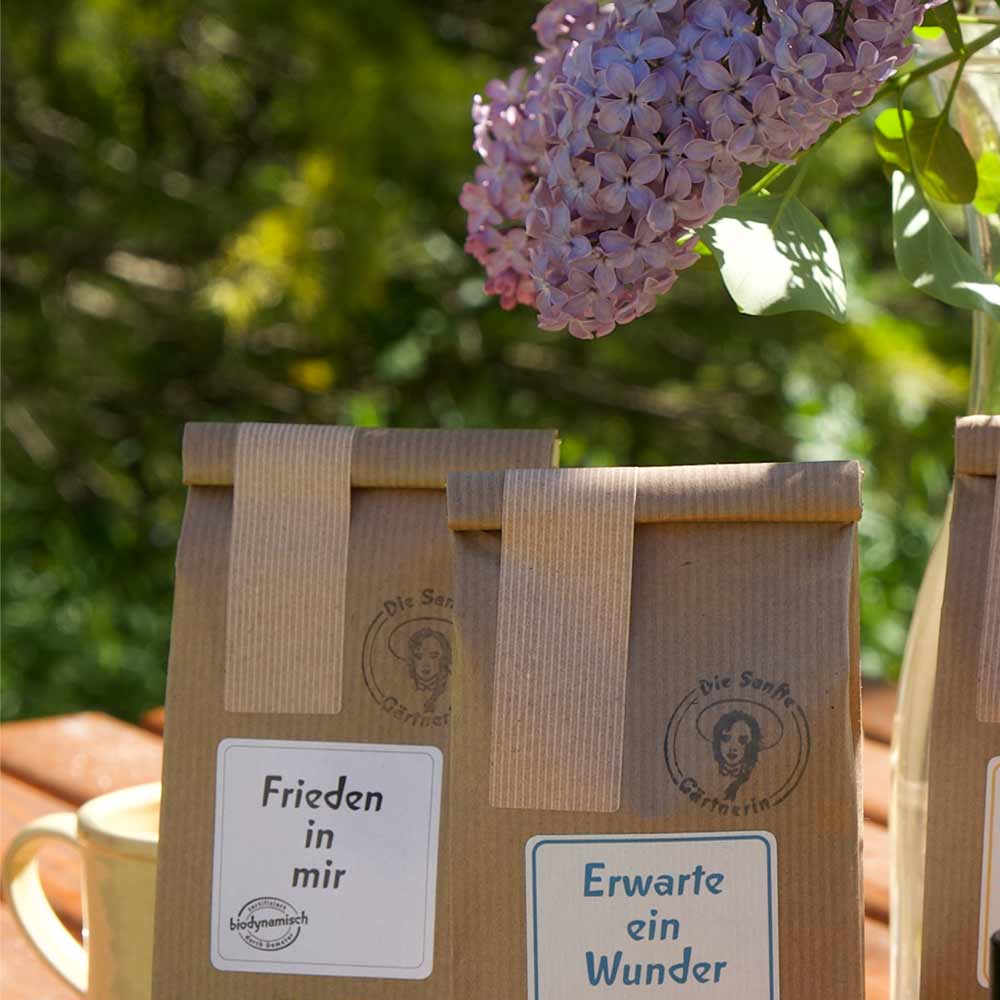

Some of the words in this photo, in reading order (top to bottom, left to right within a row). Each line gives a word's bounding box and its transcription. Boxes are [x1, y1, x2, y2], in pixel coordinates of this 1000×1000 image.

[384, 596, 415, 617] Die
[421, 588, 454, 609] San
[698, 674, 732, 696] Die
[739, 670, 796, 709] Sanfte
[380, 696, 452, 728] Gärtner
[261, 775, 384, 812] Frieden
[679, 777, 772, 817] Gärtnerin
[304, 819, 334, 849] in
[291, 860, 347, 889] mir
[583, 862, 725, 898] Erwarte
[229, 910, 309, 933] biodynamisch
[626, 909, 681, 941] ein
[585, 946, 728, 987] Wunder
